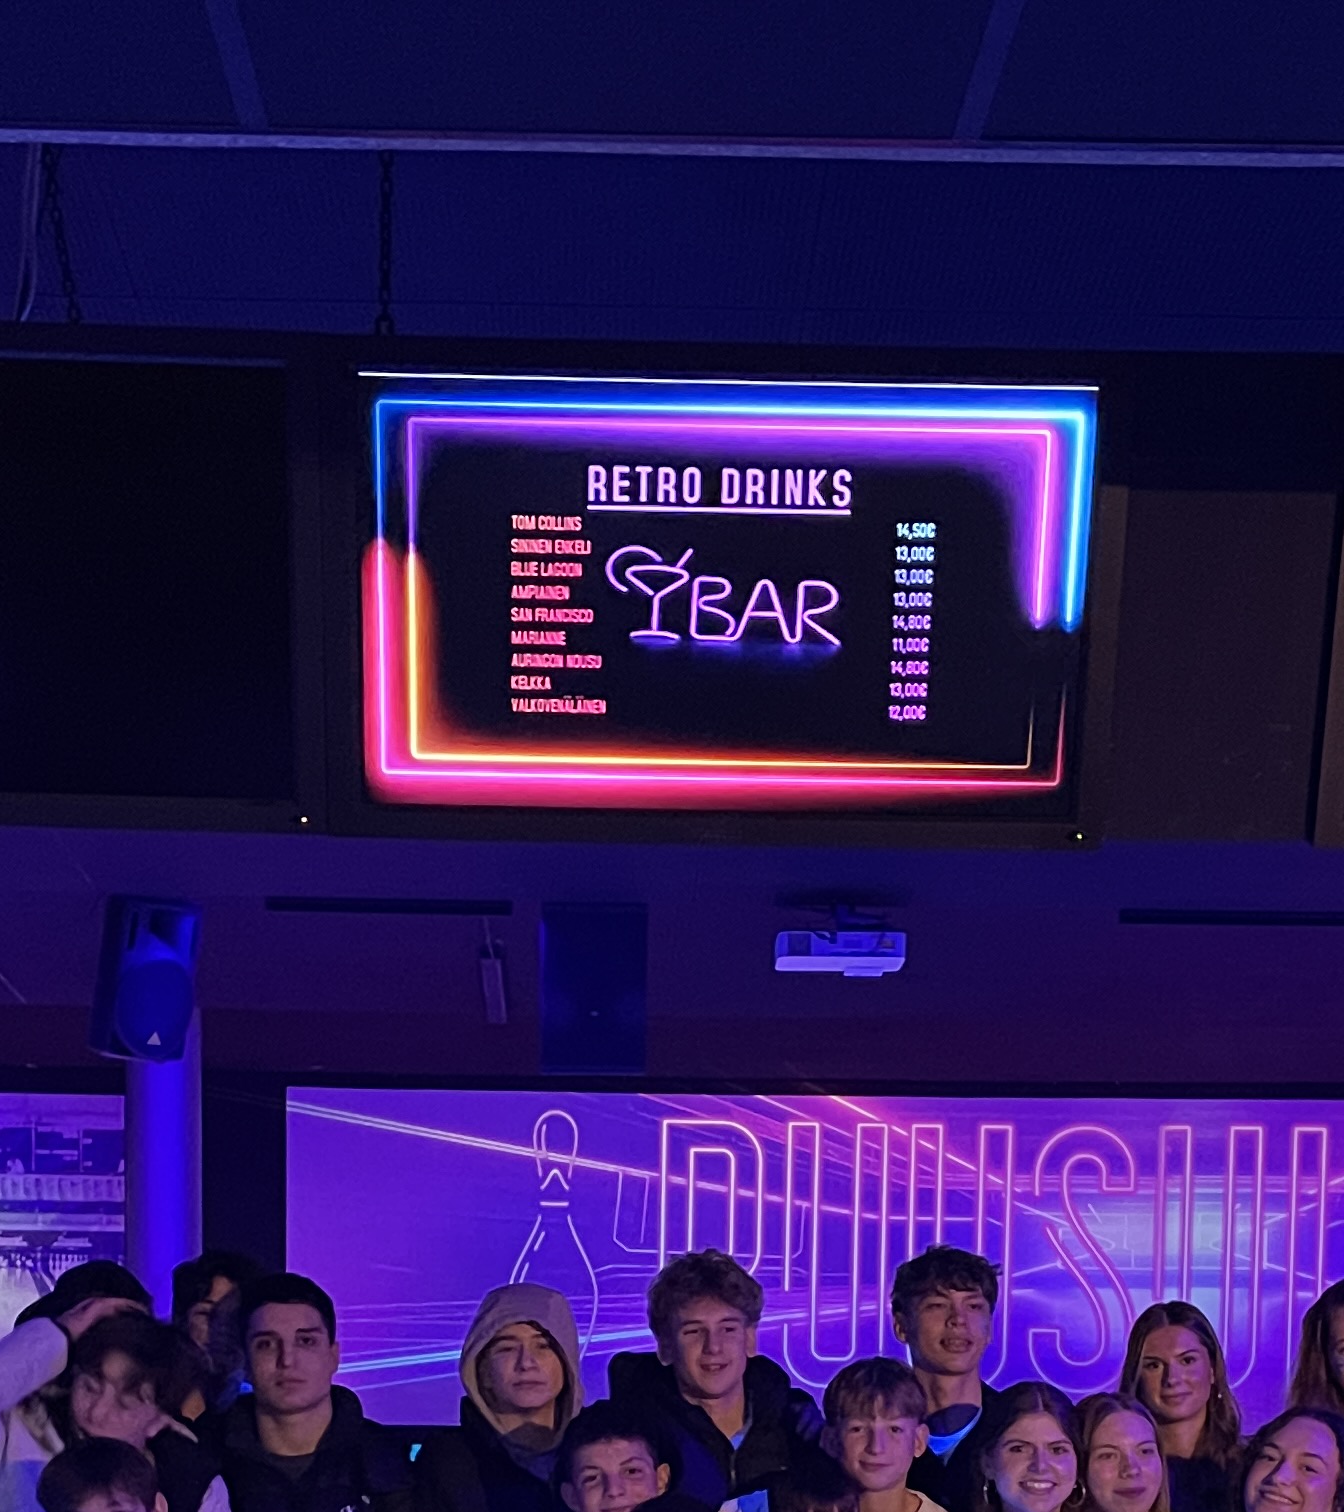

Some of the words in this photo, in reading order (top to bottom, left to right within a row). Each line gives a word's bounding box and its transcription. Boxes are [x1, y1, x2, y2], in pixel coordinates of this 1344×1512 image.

[586, 464, 702, 503] RETRO
[721, 467, 853, 507] DRINKS
[511, 515, 536, 530] TOM
[690, 574, 842, 646] BAR
